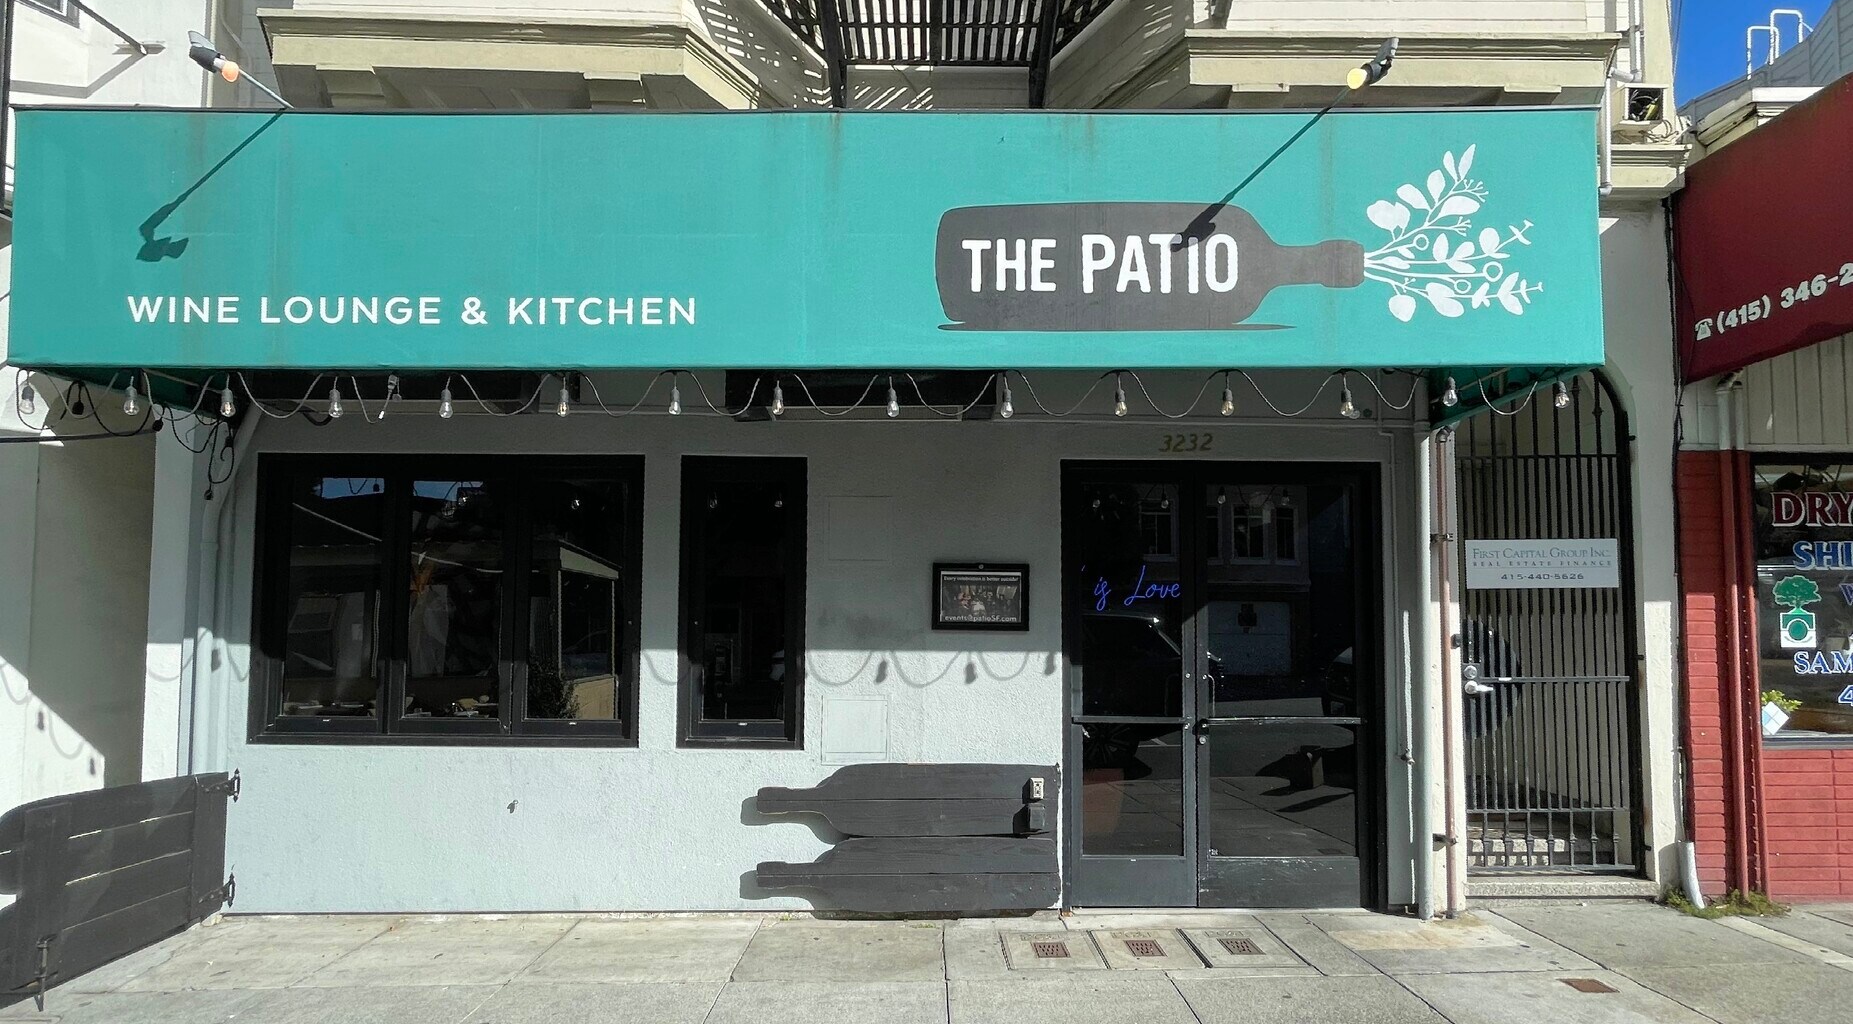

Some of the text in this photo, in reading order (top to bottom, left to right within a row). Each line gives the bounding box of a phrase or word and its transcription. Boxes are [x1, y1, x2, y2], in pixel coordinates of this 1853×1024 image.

[961, 233, 1239, 294] THE PATIO
[127, 295, 696, 326] WINE LOUNGE & KITCHEN
[1716, 262, 1853, 334] (415) 346-2
[1159, 433, 1213, 453] 3232
[1771, 491, 1853, 527] DRY
[1124, 565, 1181, 607] Love
[1793, 651, 1853, 675] SAM
